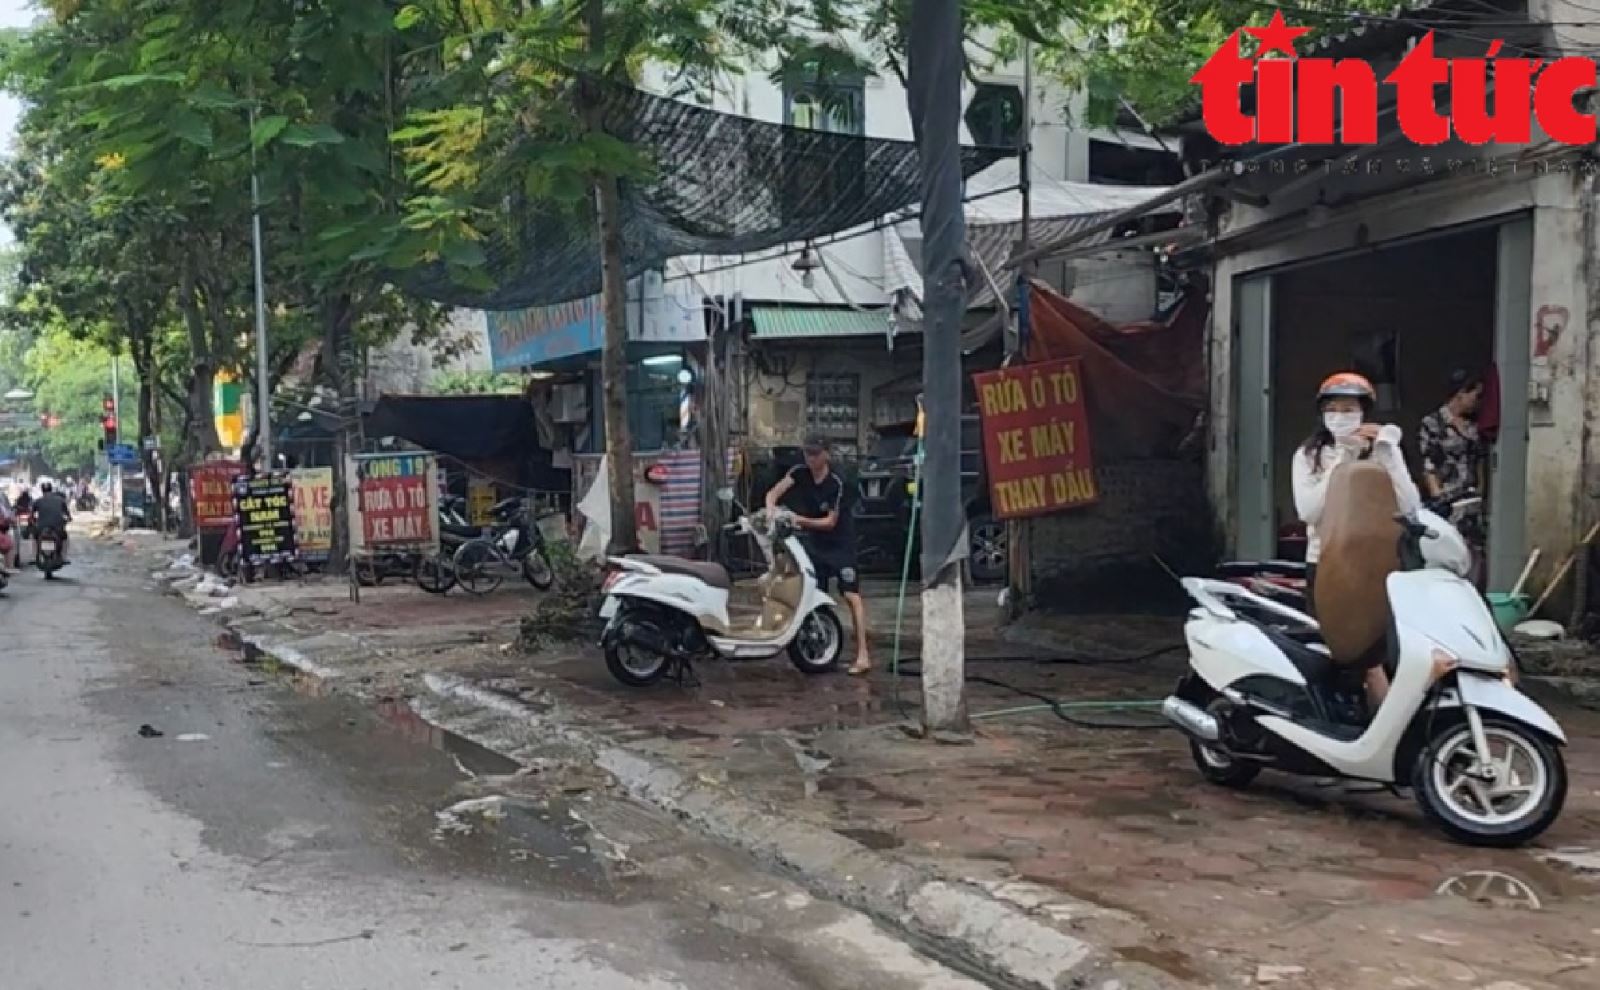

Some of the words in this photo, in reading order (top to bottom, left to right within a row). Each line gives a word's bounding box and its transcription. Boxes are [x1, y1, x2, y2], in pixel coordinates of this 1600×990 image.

[982, 370, 1028, 417] RỬA
[997, 428, 1027, 464] XE
[1029, 417, 1075, 459] MÁY
[994, 474, 1047, 513] THAY
[372, 518, 389, 540] XE
